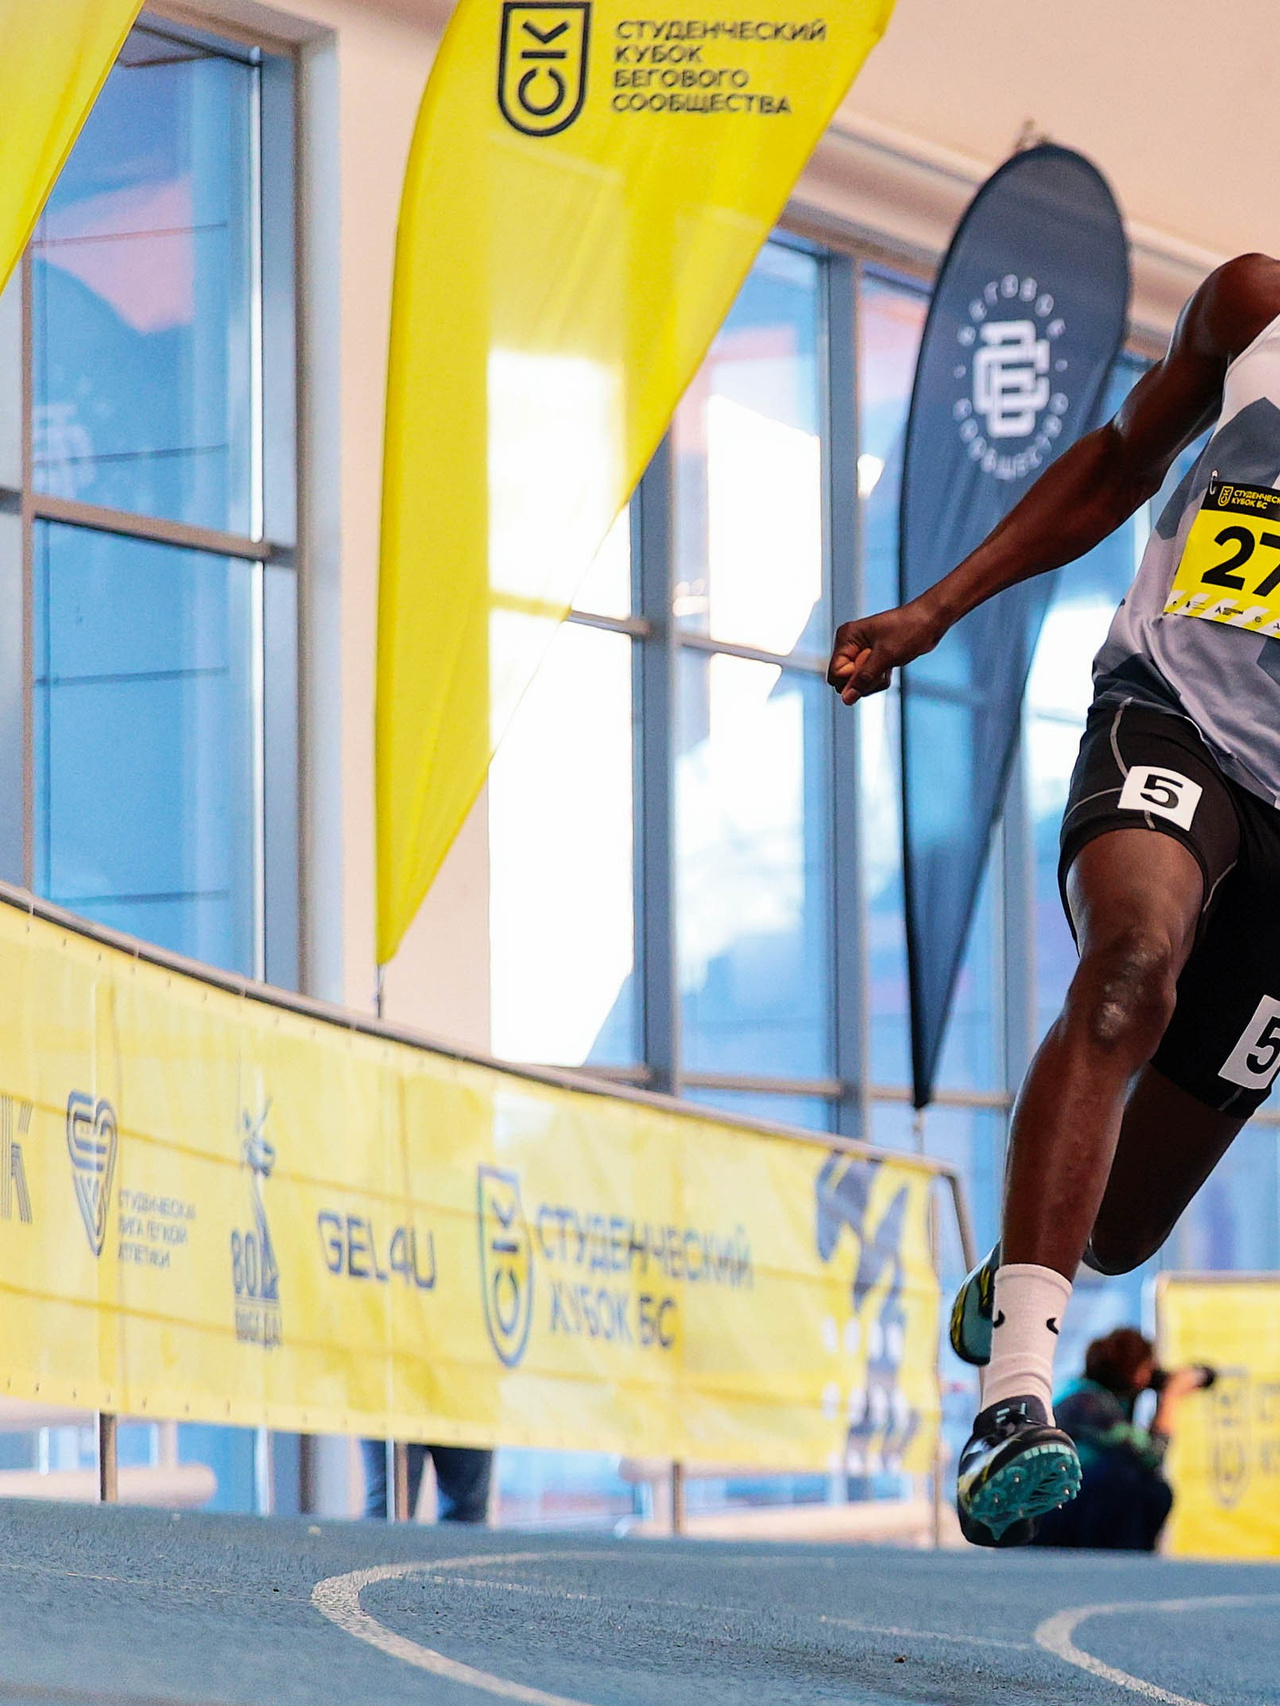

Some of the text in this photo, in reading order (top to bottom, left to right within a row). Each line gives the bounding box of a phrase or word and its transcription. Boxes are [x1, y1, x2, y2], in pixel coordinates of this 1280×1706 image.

[615, 19, 827, 42] СТУДЕНЧЕСКИЙ
[614, 44, 704, 63] КУБОК
[613, 68, 750, 89] БЕГОВОГО
[612, 93, 792, 115] СООБЩЕСТВА
[1231, 497, 1268, 509] КУБОК БС
[1140, 773, 1184, 810] 5
[318, 1210, 437, 1290] GEL4U
[535, 1203, 754, 1289] СТУДЕНЧЕСКИЙ
[550, 1281, 677, 1351] КУБОК БС
